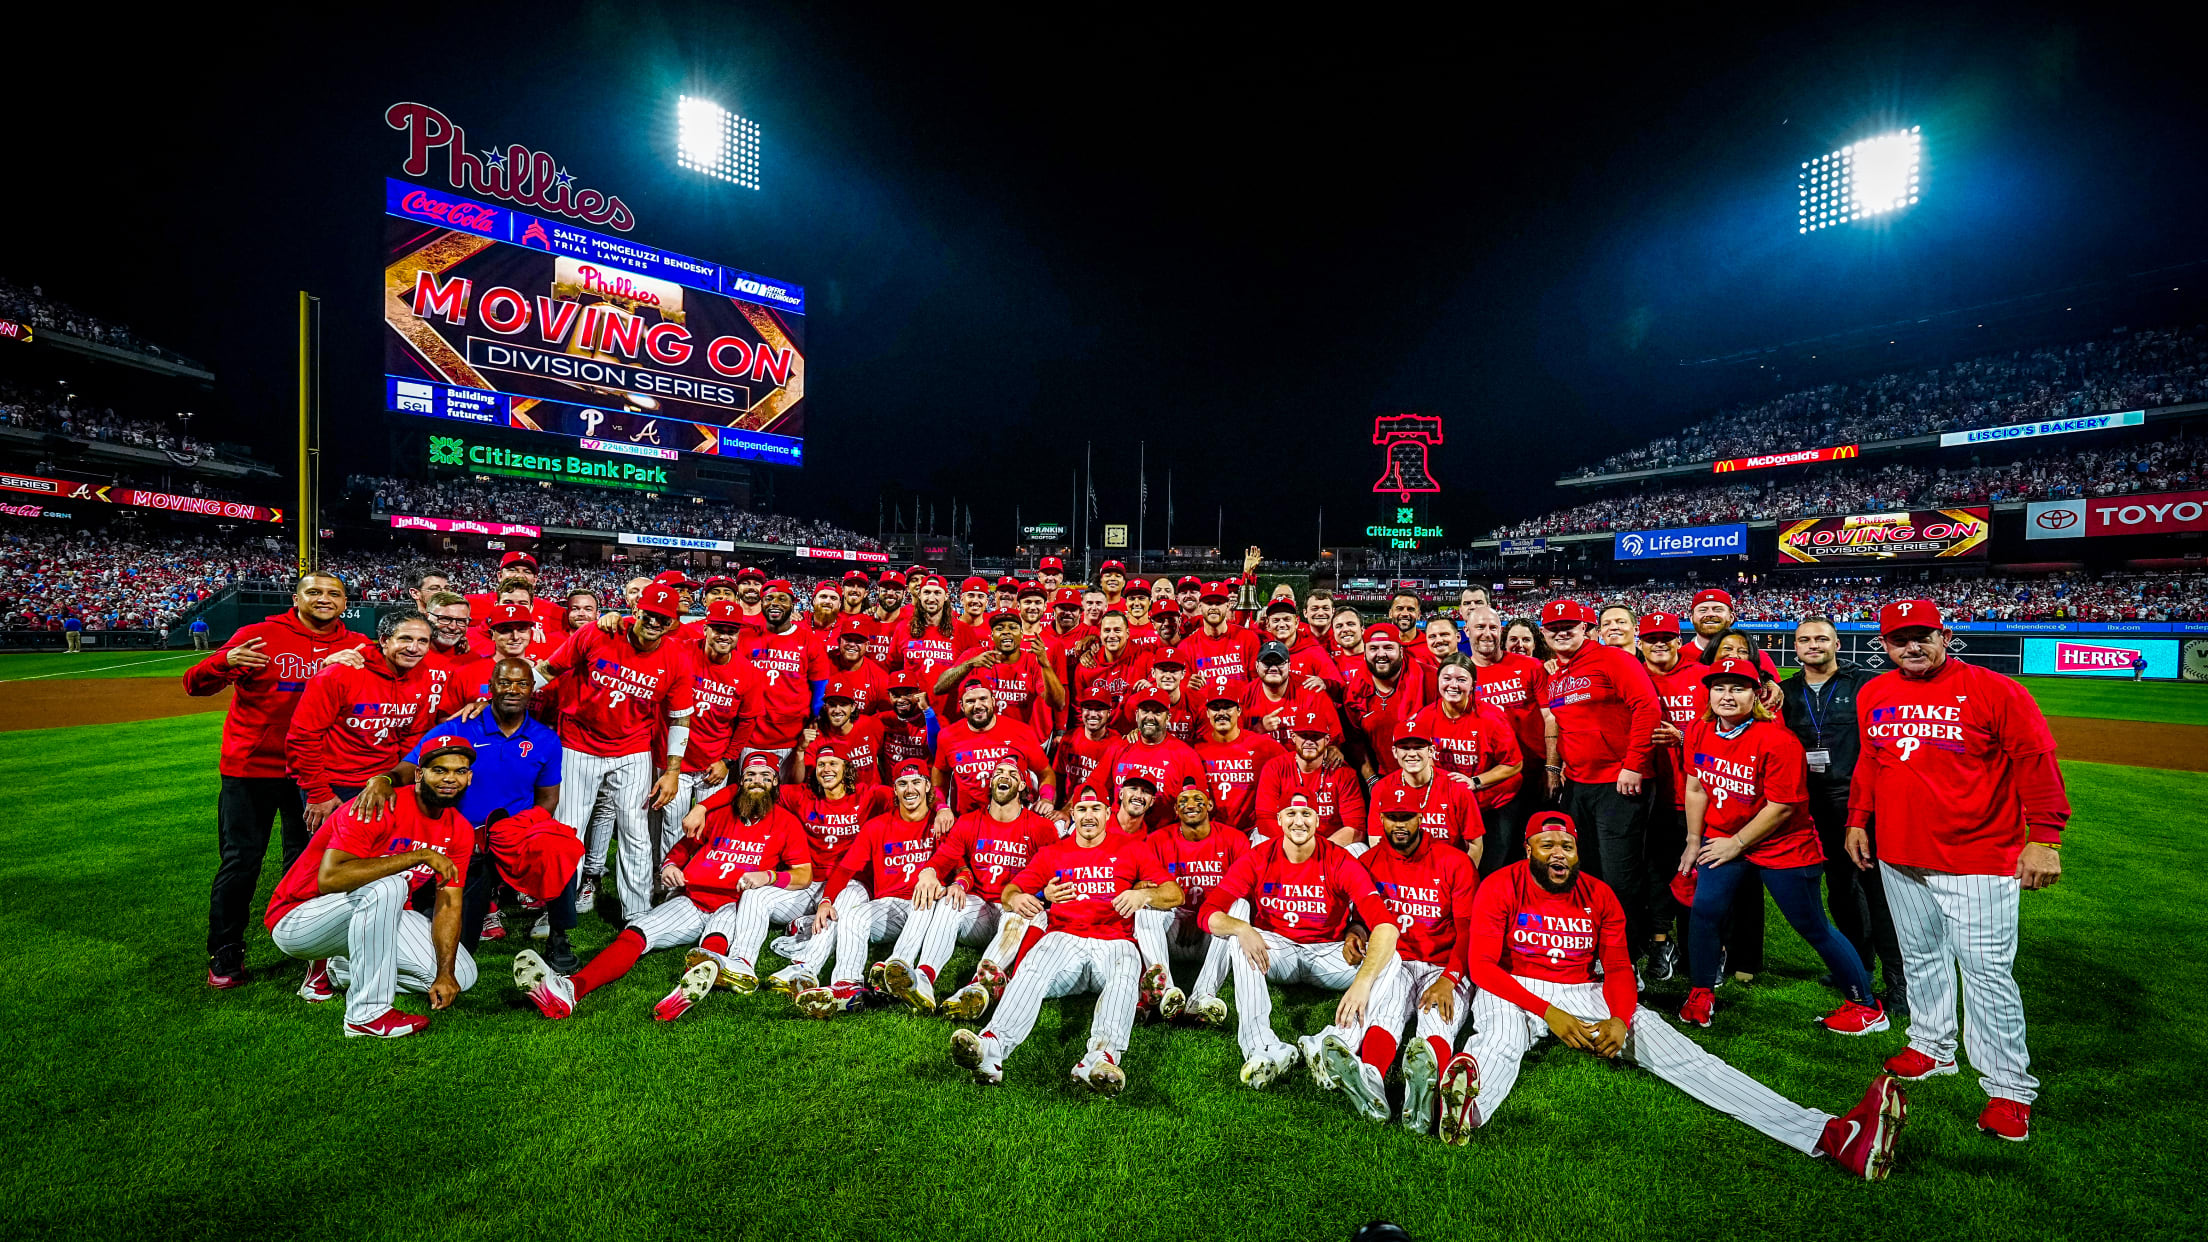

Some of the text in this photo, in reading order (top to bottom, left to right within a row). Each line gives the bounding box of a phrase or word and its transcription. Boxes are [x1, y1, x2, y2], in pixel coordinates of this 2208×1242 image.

[385, 102, 635, 232] Phillies
[402, 190, 498, 232] Coca-Cola
[553, 229, 713, 277] SALTZ MONGELUZZI BENDESKY
[554, 240, 648, 269] TRIAL LAWYERS
[578, 265, 660, 306] Phillies
[0, 320, 18, 337] N
[412, 270, 794, 388] MOVING ON
[488, 346, 736, 405] DIVISION SERIES
[447, 388, 495, 405] Building
[447, 398, 480, 412] brave
[580, 409, 604, 436] P
[1968, 416, 2110, 442] LISCIO'S BAKERY
[723, 436, 790, 455] Independence
[469, 446, 668, 484] Citizens Bank Park
[1747, 450, 1819, 467] McDonald's
[1, 477, 50, 490] SERIES
[133, 491, 255, 519] MOVING ON
[395, 516, 437, 530] JIM BEAM
[449, 520, 488, 534] JIM BEAM
[1856, 516, 1897, 525] Phillies
[500, 524, 537, 537] JIM BEAM
[1366, 525, 1443, 537] Citizens Bank
[1789, 522, 1980, 546] MOVING ON
[637, 535, 717, 549] LISCIO'S BAKERY
[1391, 538, 1416, 549] Park
[1650, 531, 1739, 550] LifeBrand
[1816, 542, 1940, 554] DIVISION SERIES
[517, 551, 528, 560] P
[811, 549, 843, 558] TOYOTA
[858, 553, 887, 562] TOYOTA
[1049, 557, 1056, 565] P
[889, 571, 897, 579] P
[1210, 582, 1219, 591] P
[657, 591, 669, 604] P
[1065, 590, 1073, 599] P
[505, 606, 517, 618] P
[725, 605, 734, 616] P
[1159, 600, 1168, 610] P
[1555, 603, 1566, 616] P
[1898, 602, 1913, 617] P
[852, 620, 860, 629] P
[1653, 615, 1664, 626] P
[2006, 623, 2057, 631] Independence
[923, 639, 953, 651] TAKE
[767, 648, 801, 662] TAKE
[906, 650, 954, 661] OCTOBER
[1166, 648, 1174, 658] P
[1210, 652, 1241, 666] TAKE
[2062, 649, 2131, 666] HERR'S
[923, 658, 935, 674] P
[1723, 660, 1735, 672] P
[619, 665, 659, 688] TAKE
[766, 669, 780, 686] P
[898, 673, 906, 683] P
[591, 669, 654, 700] OCTOBER
[703, 677, 736, 696] TAKE
[834, 683, 843, 692] P
[996, 679, 1026, 691] TAKE
[1092, 687, 1100, 697] P
[1150, 687, 1158, 697] P
[1216, 685, 1225, 695] P
[1483, 677, 1523, 694] TAKE
[609, 690, 626, 709] P
[379, 702, 418, 715] TAKE
[695, 701, 711, 718] P
[996, 700, 1008, 716] P
[1898, 705, 1961, 722] TAKE
[1306, 712, 1315, 723] P
[1406, 721, 1416, 733] P
[1867, 723, 1964, 741] OCTOBER
[438, 735, 451, 747] P
[1440, 737, 1476, 752] TAKE
[518, 741, 534, 758] P
[973, 747, 1010, 760] TAKE
[1896, 737, 1920, 762] P
[1215, 759, 1253, 770] TAKE
[1714, 757, 1754, 780] TAKE
[975, 772, 991, 788] P
[1139, 768, 1149, 778] P
[1217, 782, 1231, 800] P
[1394, 790, 1405, 803] P
[1712, 787, 1728, 809] P
[825, 813, 858, 825] TAKE
[730, 839, 765, 853] TAKE
[824, 835, 838, 849] P
[992, 839, 1027, 855] TAKE
[706, 850, 762, 866] OCTOBER
[974, 853, 1027, 867] OCTOBER
[719, 862, 735, 880] P
[902, 863, 916, 883] P
[1073, 865, 1114, 880] TAKE
[1186, 860, 1222, 873] TAKE
[989, 865, 1004, 884] P
[1282, 883, 1325, 898] TAKE
[1398, 885, 1439, 903] TAKE
[1260, 896, 1327, 914] OCTOBER
[1283, 911, 1299, 928] P
[1396, 914, 1415, 934] P
[1544, 915, 1593, 933] TAKE
[1513, 930, 1593, 949] OCTOBER
[1546, 948, 1566, 965] P
